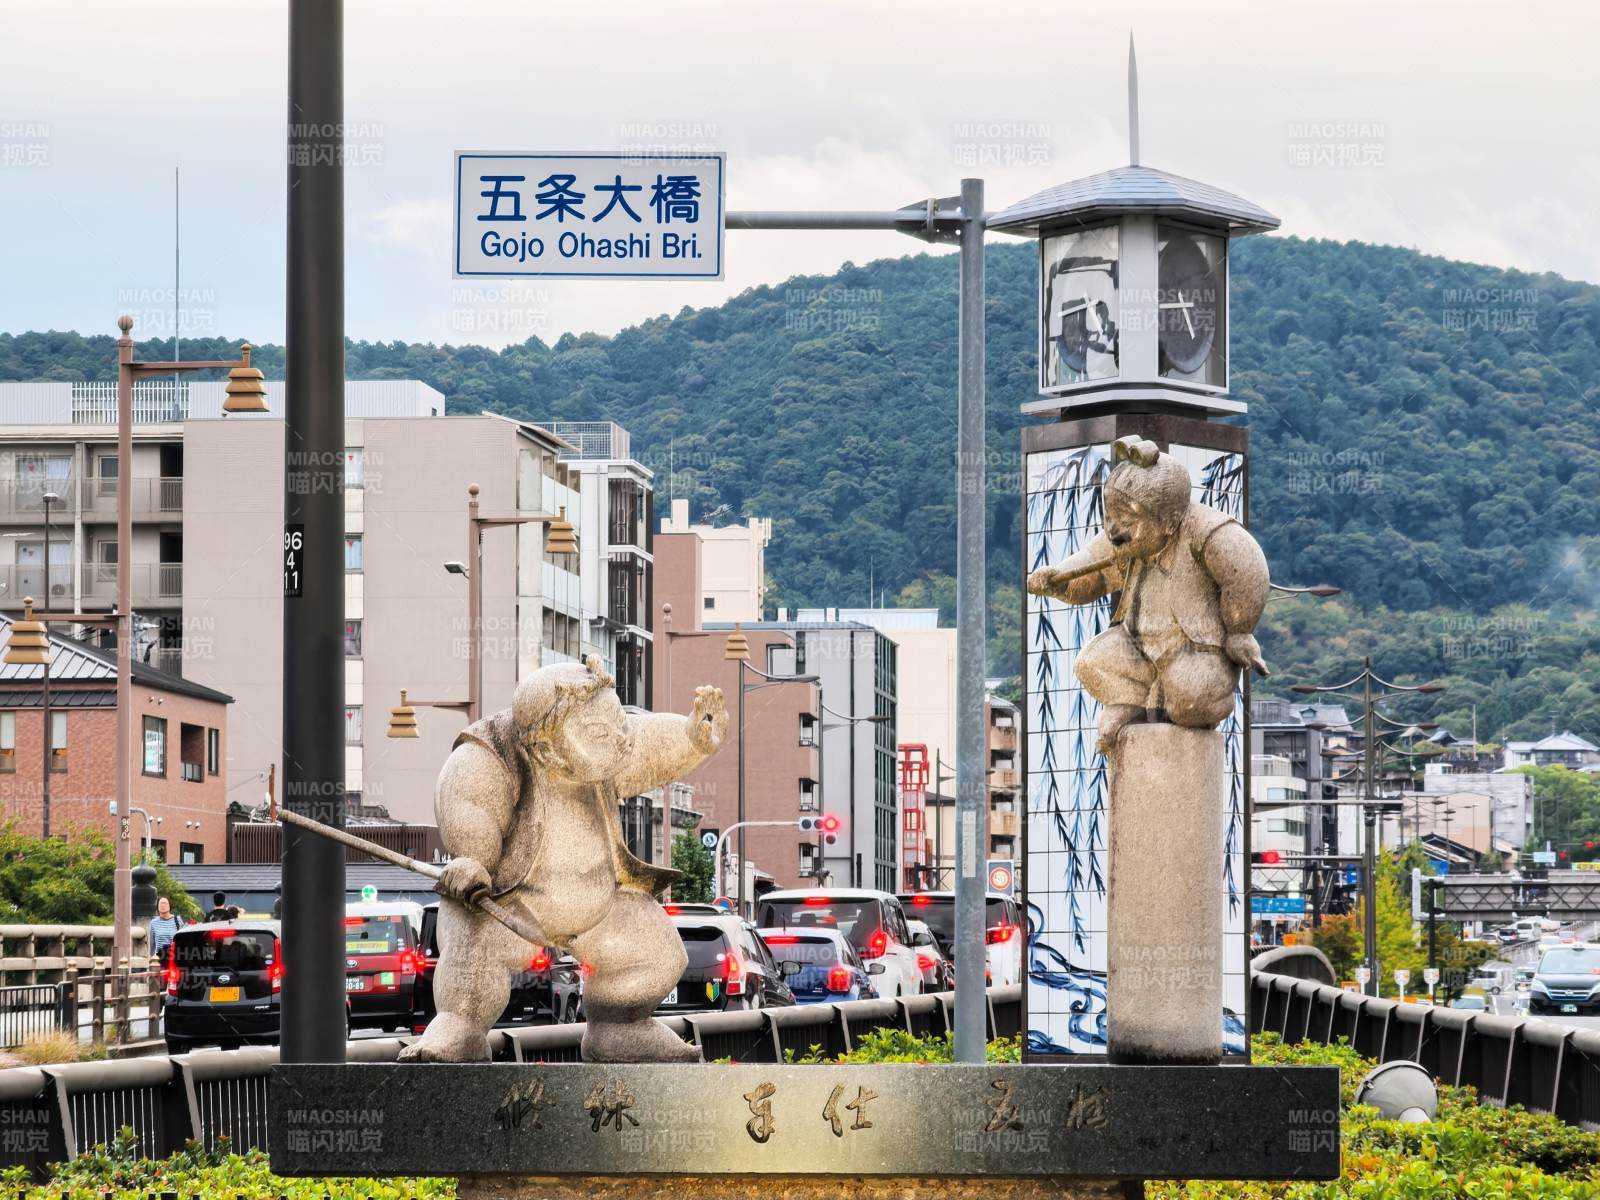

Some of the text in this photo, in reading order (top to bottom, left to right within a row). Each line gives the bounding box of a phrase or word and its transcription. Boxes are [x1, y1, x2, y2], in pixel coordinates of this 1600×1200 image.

[477, 174, 701, 224] 五条大橋
[480, 230, 702, 263] Gojo Ohashi Bri.
[284, 531, 302, 551] 96
[286, 551, 296, 570] 4
[284, 570, 298, 590] 11
